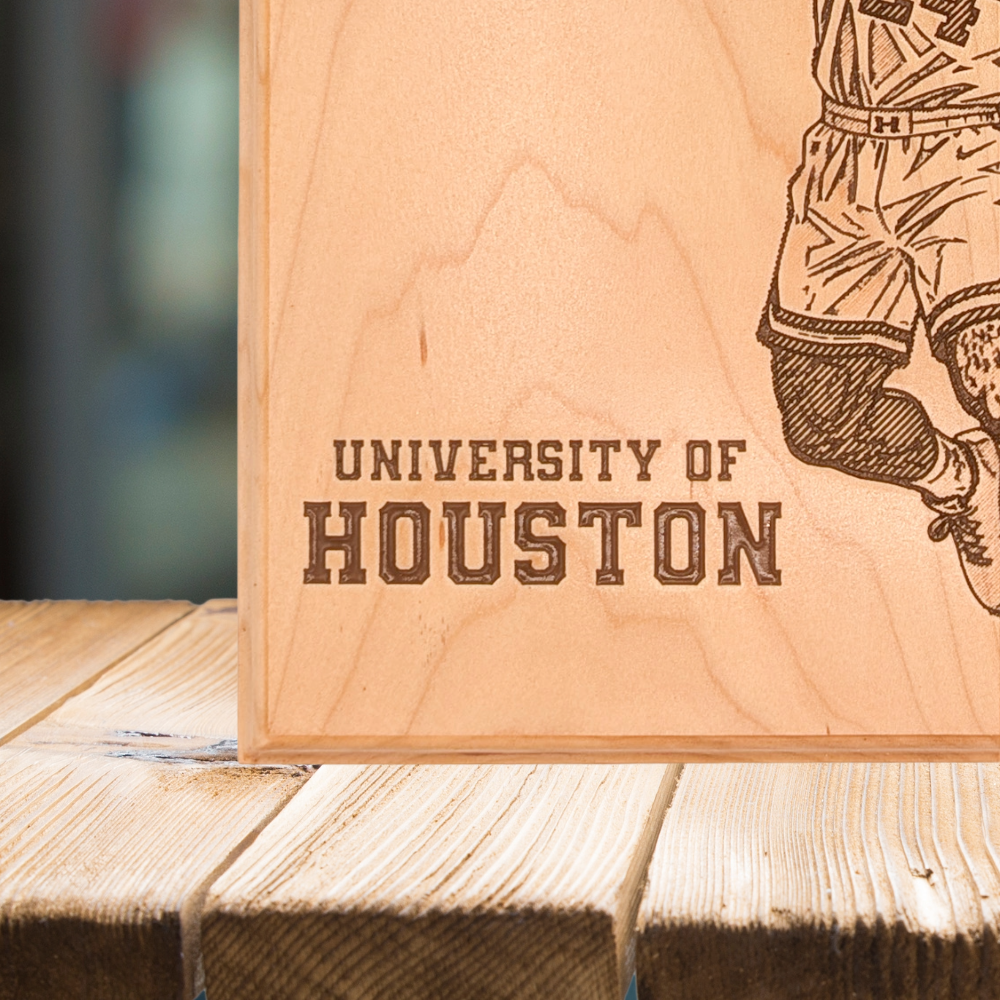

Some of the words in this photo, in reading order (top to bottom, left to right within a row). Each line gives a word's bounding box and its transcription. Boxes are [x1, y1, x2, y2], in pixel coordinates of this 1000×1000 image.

[333, 439, 662, 481] UNIVERSITY
[685, 439, 747, 481] OF
[303, 501, 782, 585] HOUSTON
